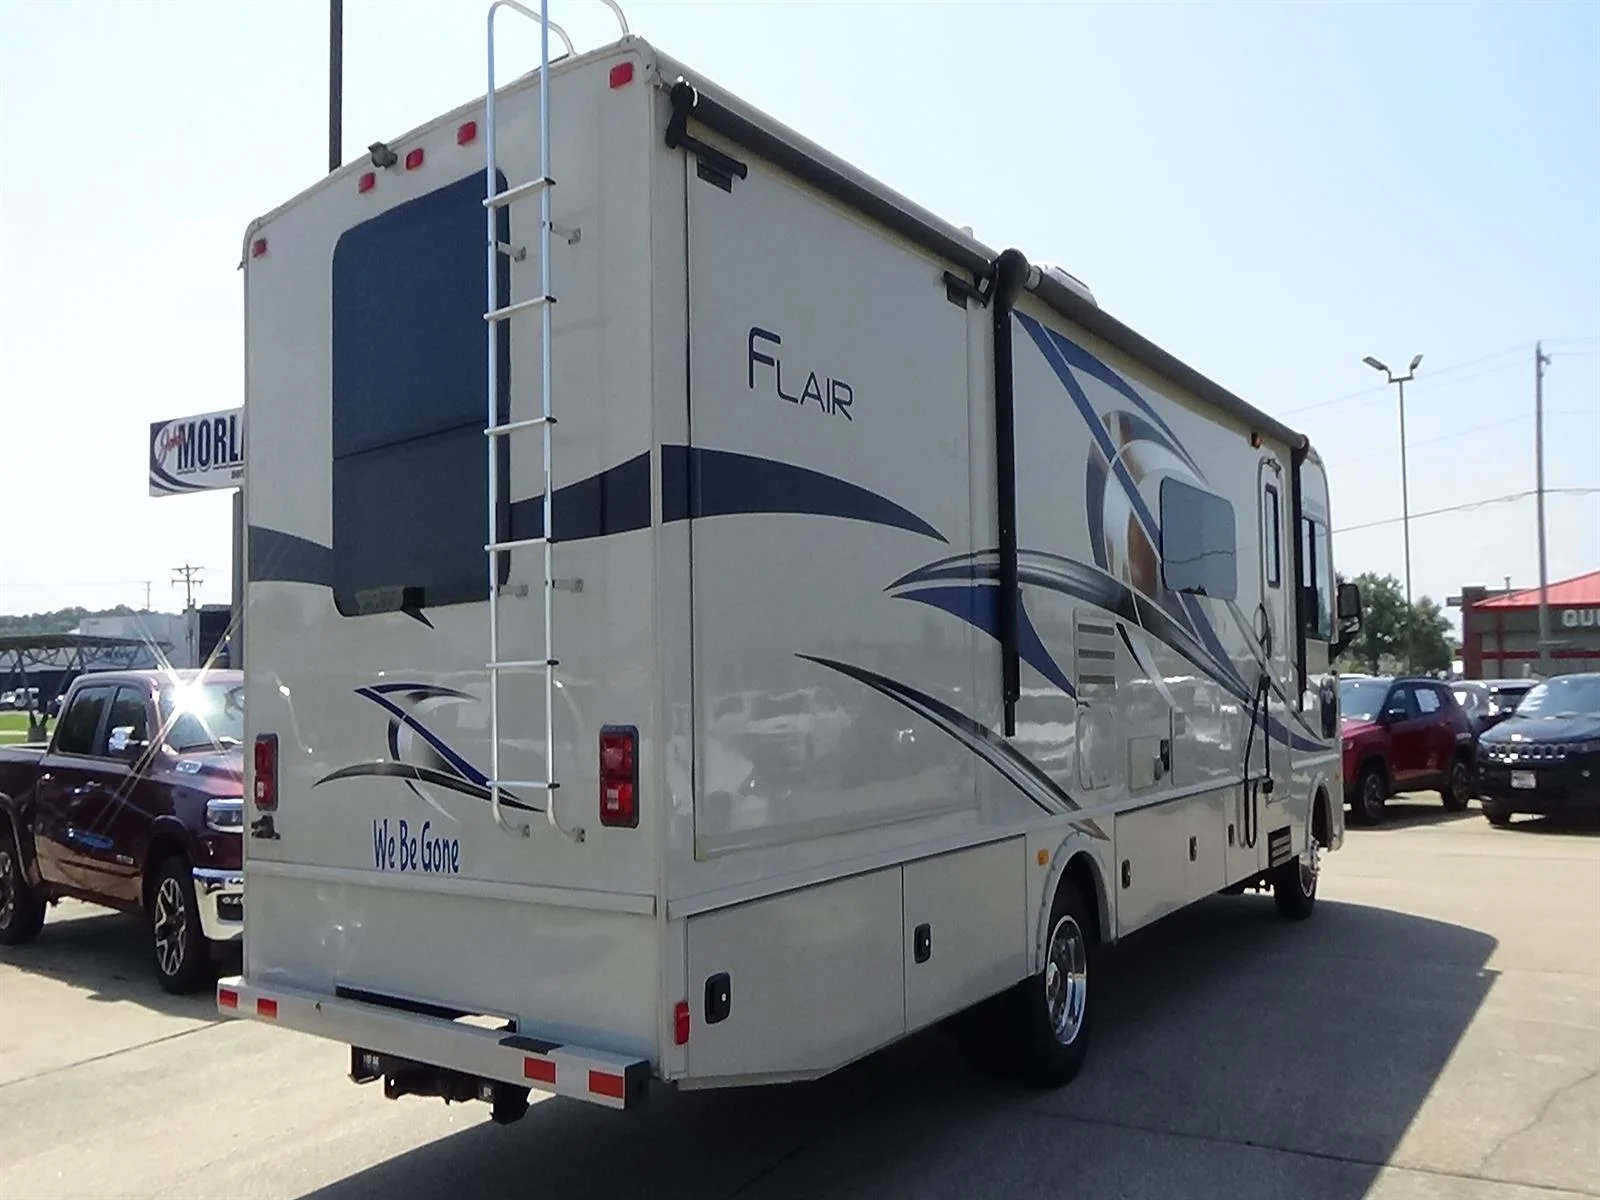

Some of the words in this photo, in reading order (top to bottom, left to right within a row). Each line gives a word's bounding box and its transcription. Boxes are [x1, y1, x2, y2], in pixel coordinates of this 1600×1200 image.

[1561, 608, 1600, 627] QU
[373, 818, 396, 871] We
[399, 819, 418, 872] Be
[421, 820, 460, 874] Gone
